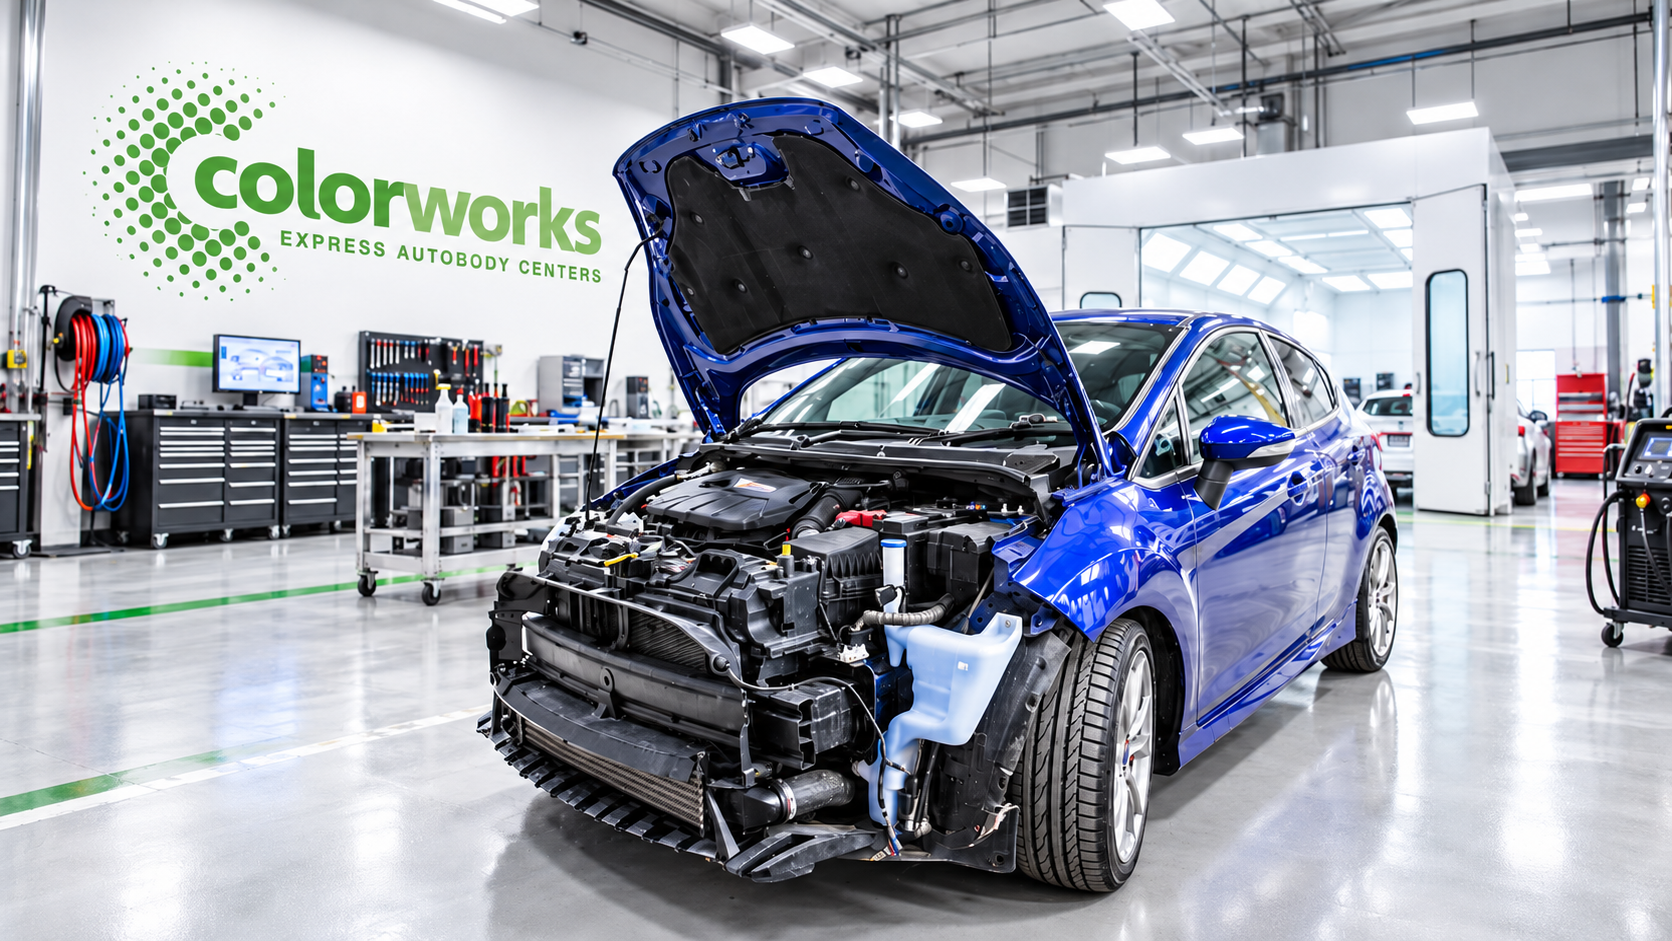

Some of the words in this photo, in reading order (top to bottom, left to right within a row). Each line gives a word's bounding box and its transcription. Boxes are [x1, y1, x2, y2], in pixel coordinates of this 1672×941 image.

[194, 147, 602, 255] colorworks
[280, 229, 386, 258] EXPRESS
[396, 244, 510, 273] AUTOBODY
[518, 259, 602, 284] CENTERS
